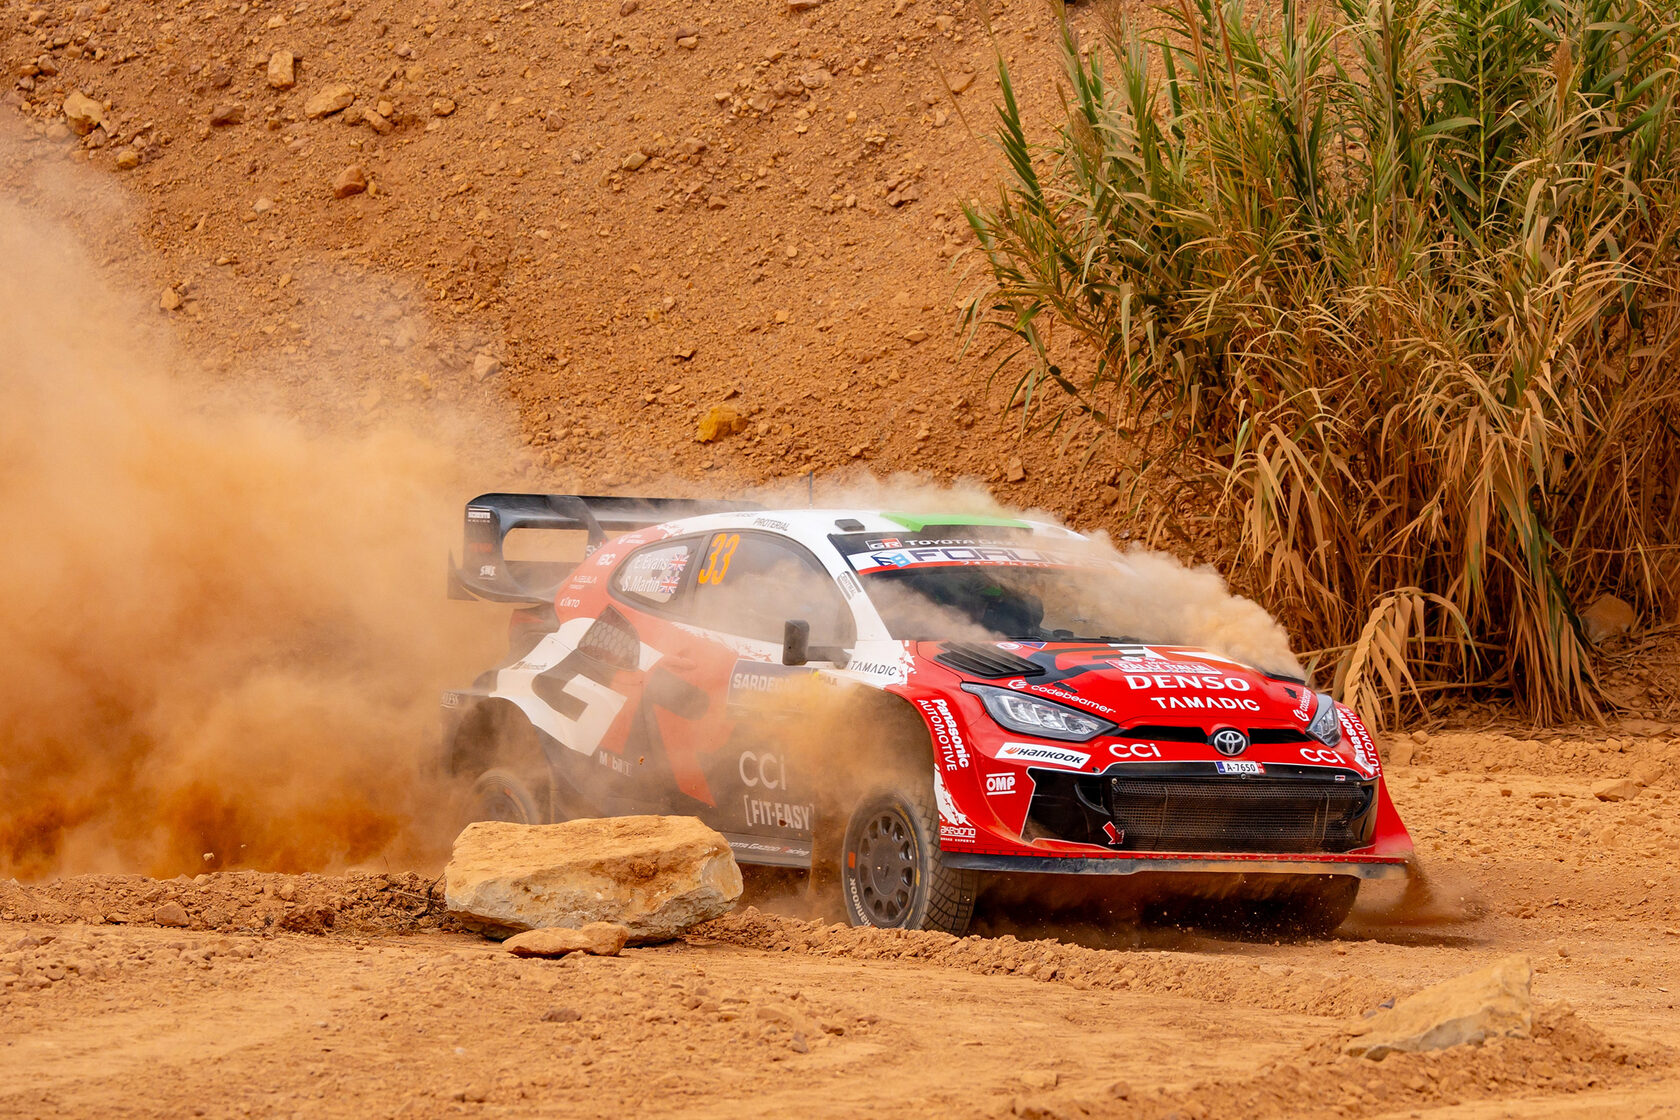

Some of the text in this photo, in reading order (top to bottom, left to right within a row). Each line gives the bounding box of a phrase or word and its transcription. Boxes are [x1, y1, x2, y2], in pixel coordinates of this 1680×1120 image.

[753, 518, 791, 532] PROTERIAL
[698, 533, 740, 585] 33
[908, 548, 1066, 562] FORU
[850, 660, 897, 676] TAMADIC
[1124, 675, 1250, 691] DENSO
[1031, 685, 1112, 714] codebeamer
[1151, 697, 1260, 711] TAMADIC
[917, 700, 957, 771] AUTOMOTIVE
[931, 699, 970, 768] Panasonic
[1227, 763, 1256, 772] A-7650
[986, 776, 1016, 791] OMP
